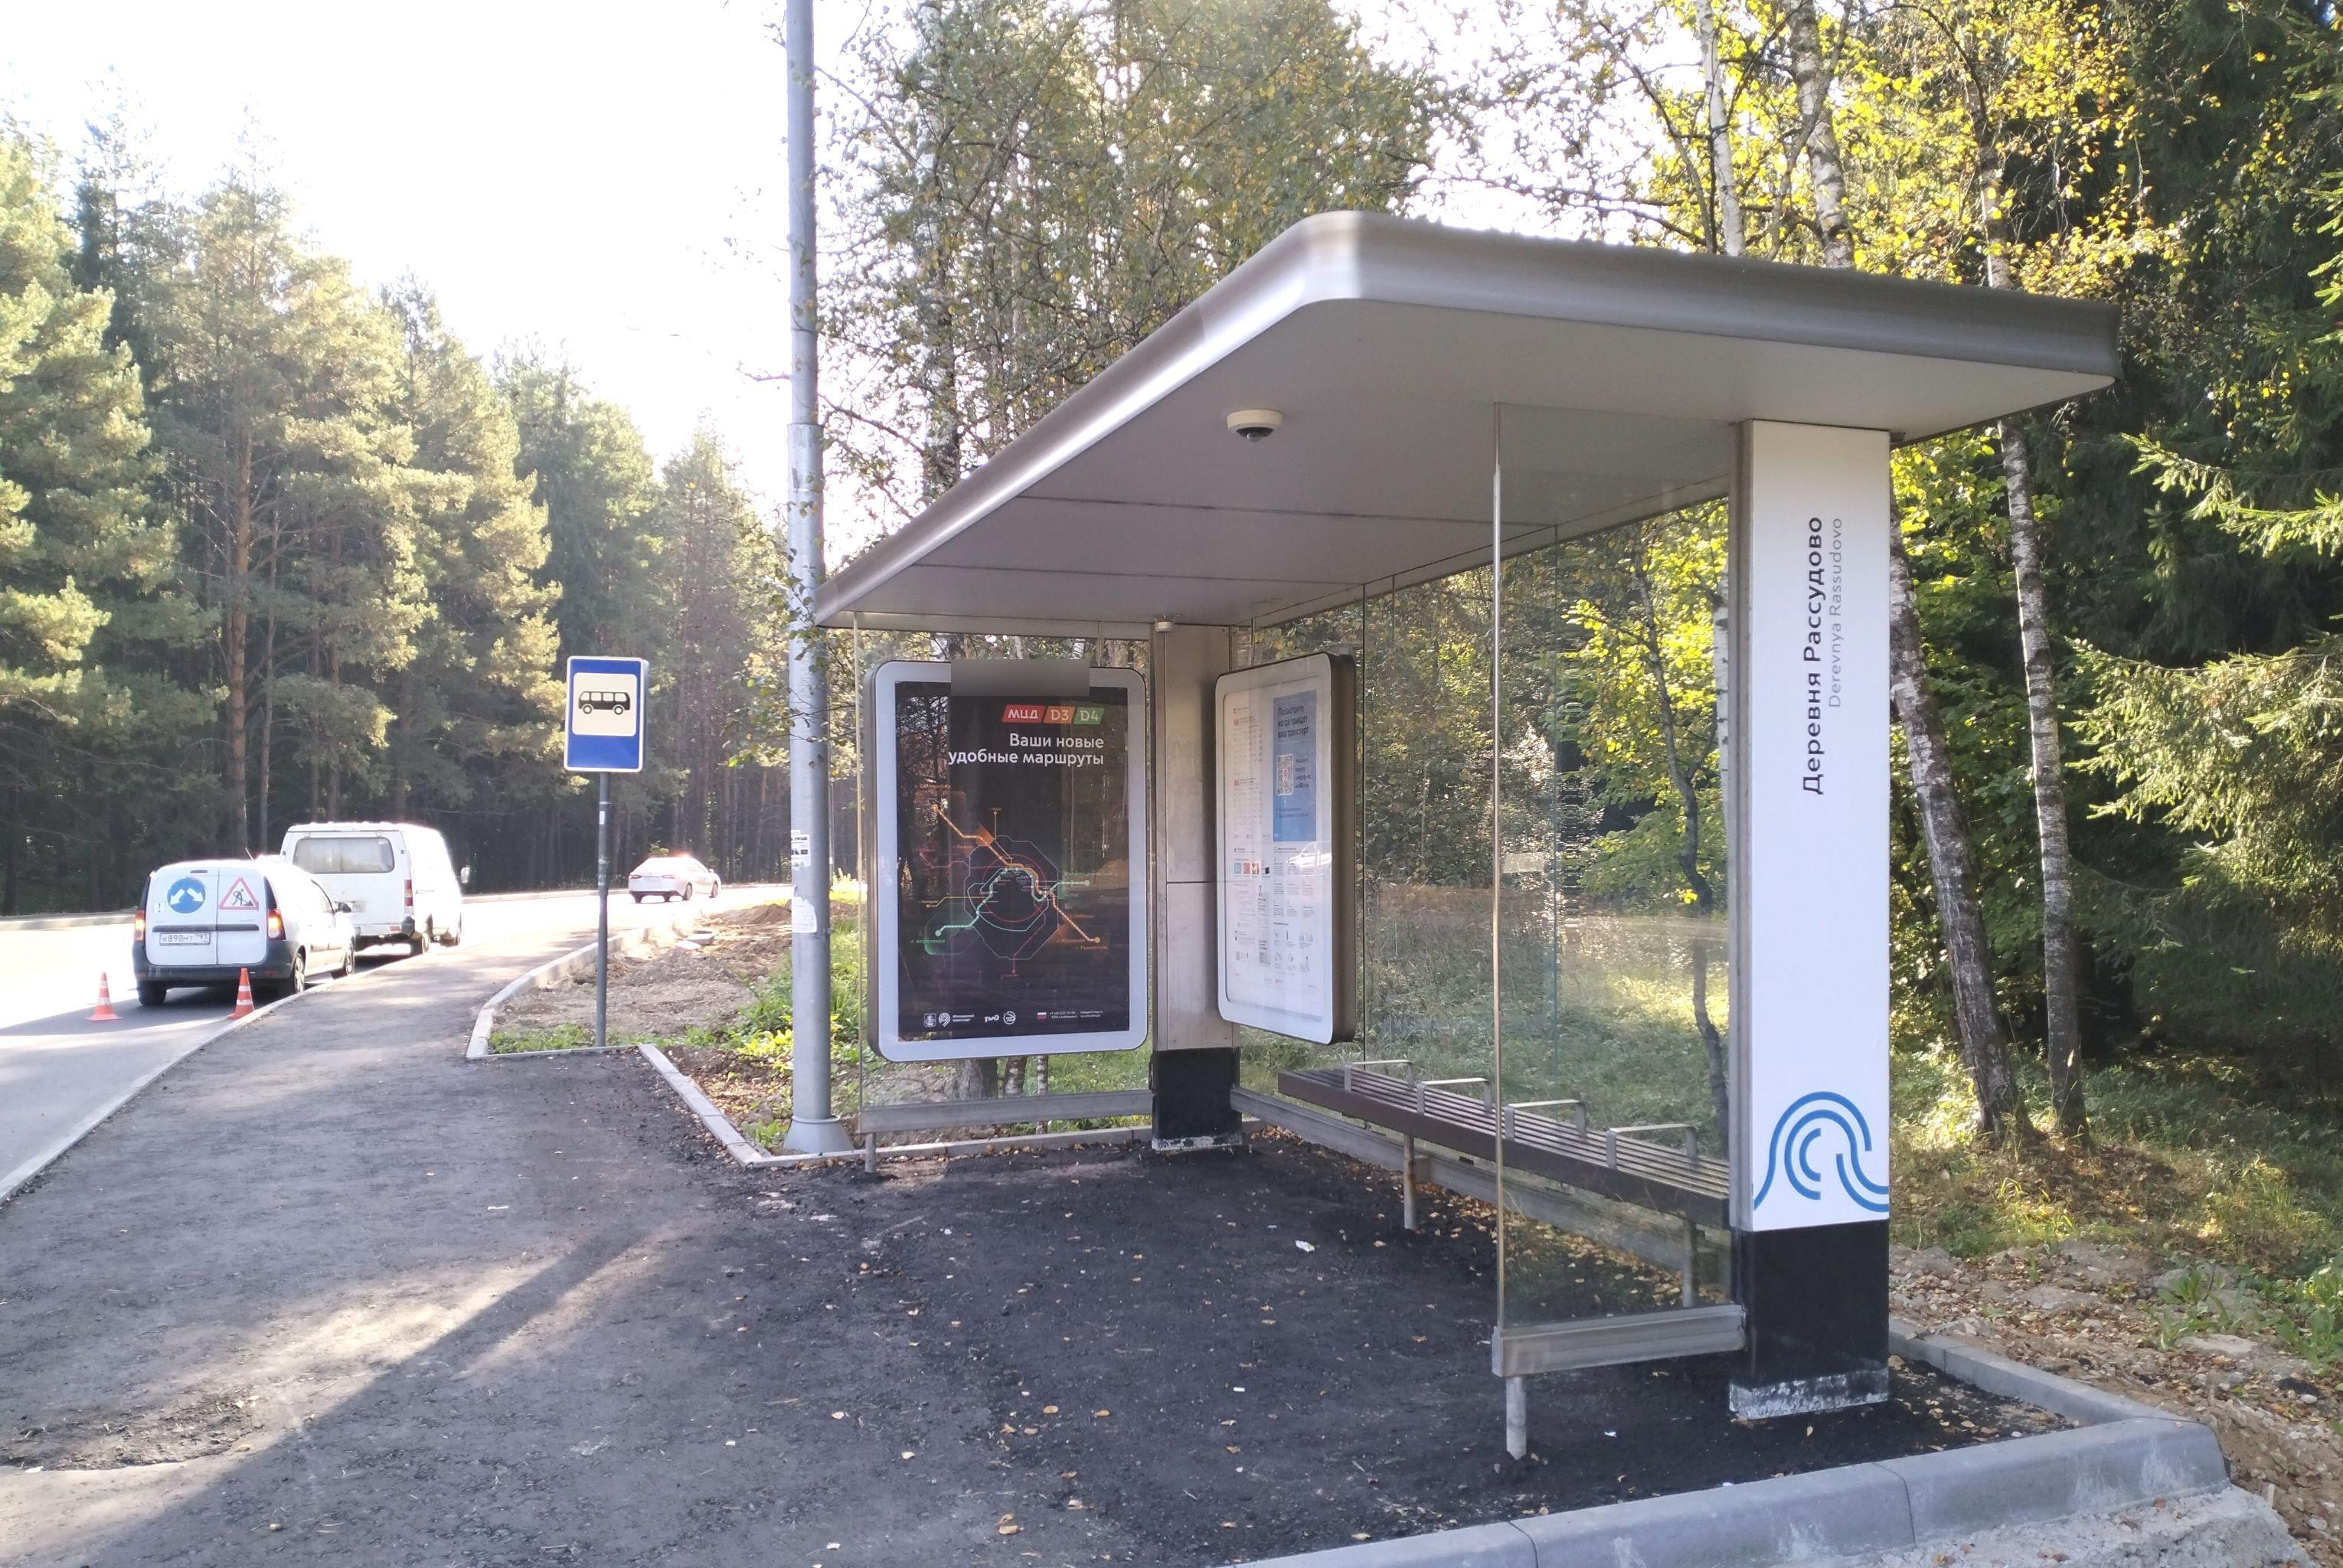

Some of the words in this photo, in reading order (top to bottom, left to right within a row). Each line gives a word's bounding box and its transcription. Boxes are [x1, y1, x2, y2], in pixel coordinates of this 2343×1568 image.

[1803, 517, 1826, 662] Рассудово
[1829, 518, 1842, 619] Rassudovo
[1828, 622, 1844, 707] Derevnya
[1008, 708, 1039, 720] МЦД
[1050, 709, 1069, 720] D3
[1080, 710, 1100, 721] D4
[1802, 673, 1825, 795] Деревня
[948, 748, 1018, 766] удобные
[1022, 753, 1104, 768] маршруты
[1009, 733, 1052, 747] Ваши
[1056, 737, 1104, 748] новые
